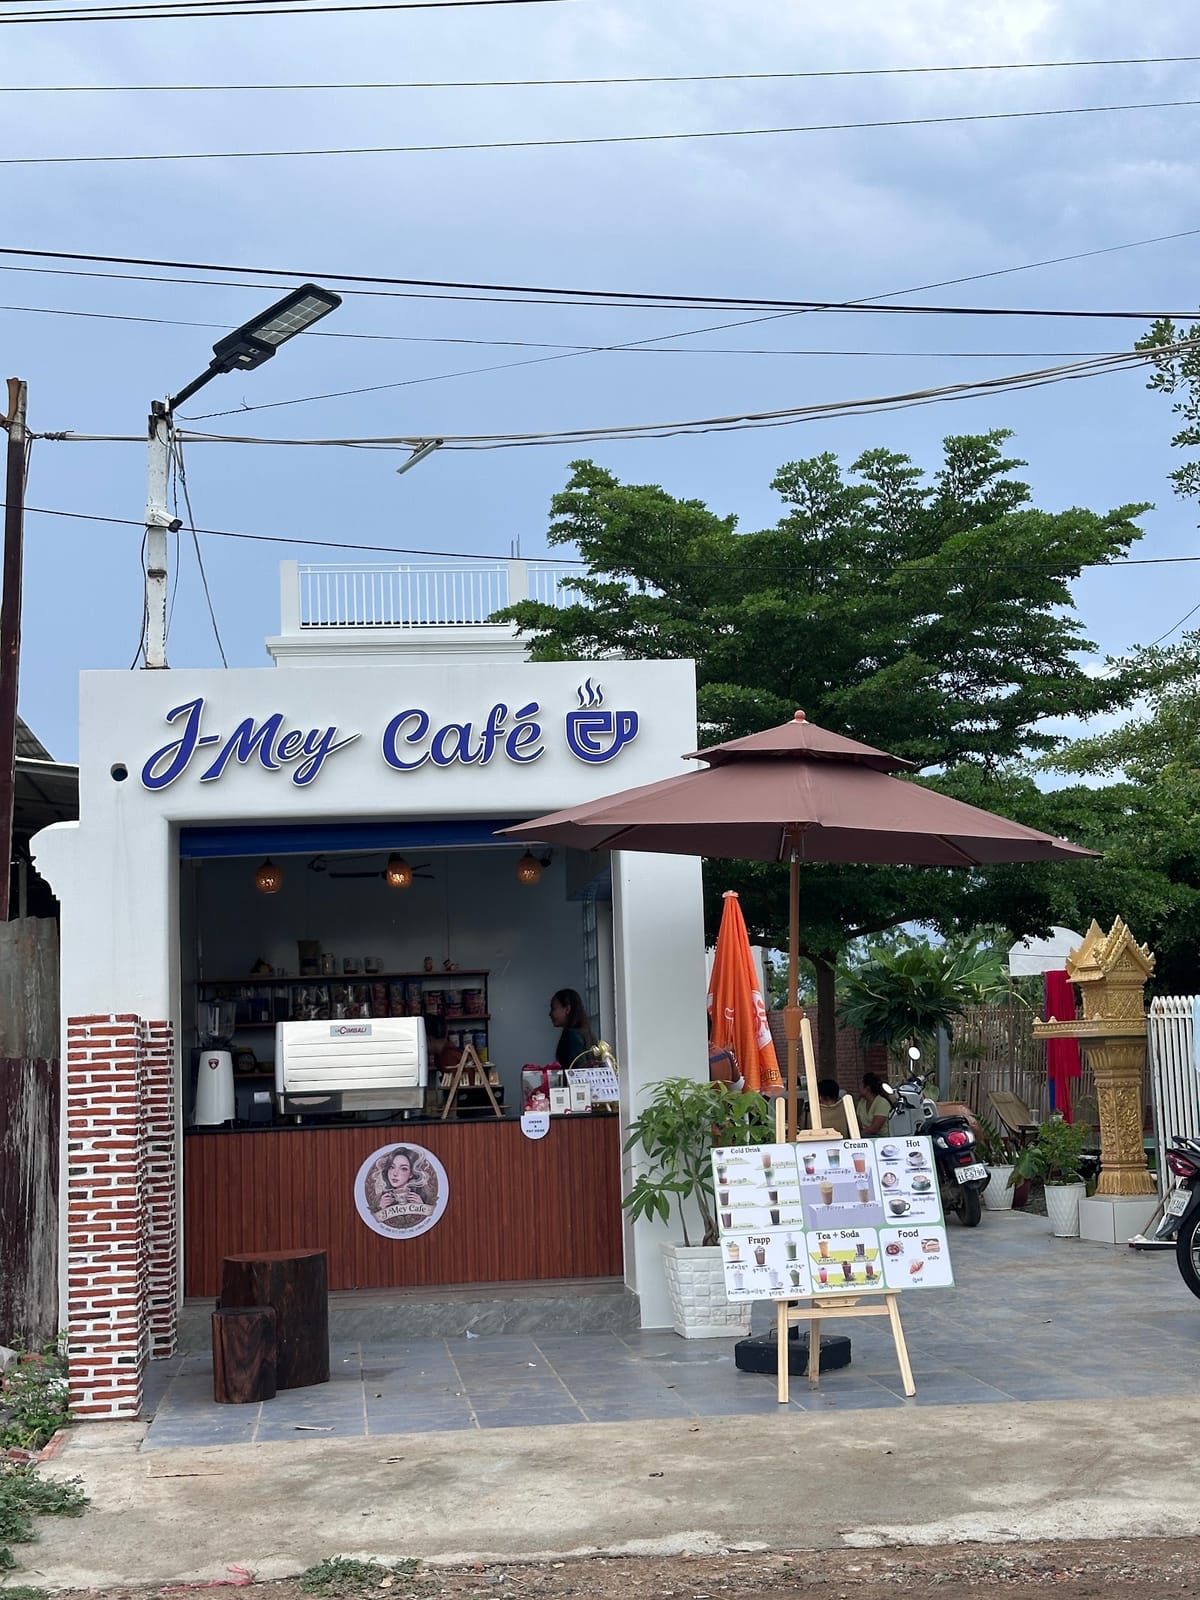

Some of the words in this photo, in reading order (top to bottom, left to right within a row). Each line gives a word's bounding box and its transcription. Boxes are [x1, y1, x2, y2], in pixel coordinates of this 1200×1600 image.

[141, 697, 361, 790] J-Mey
[381, 701, 545, 771] Café
[843, 1141, 869, 1149] Cream
[816, 1232, 831, 1240] Tea
[840, 1230, 860, 1238] Soda
[898, 1229, 919, 1238] Food
[747, 1236, 771, 1245] Frapp
